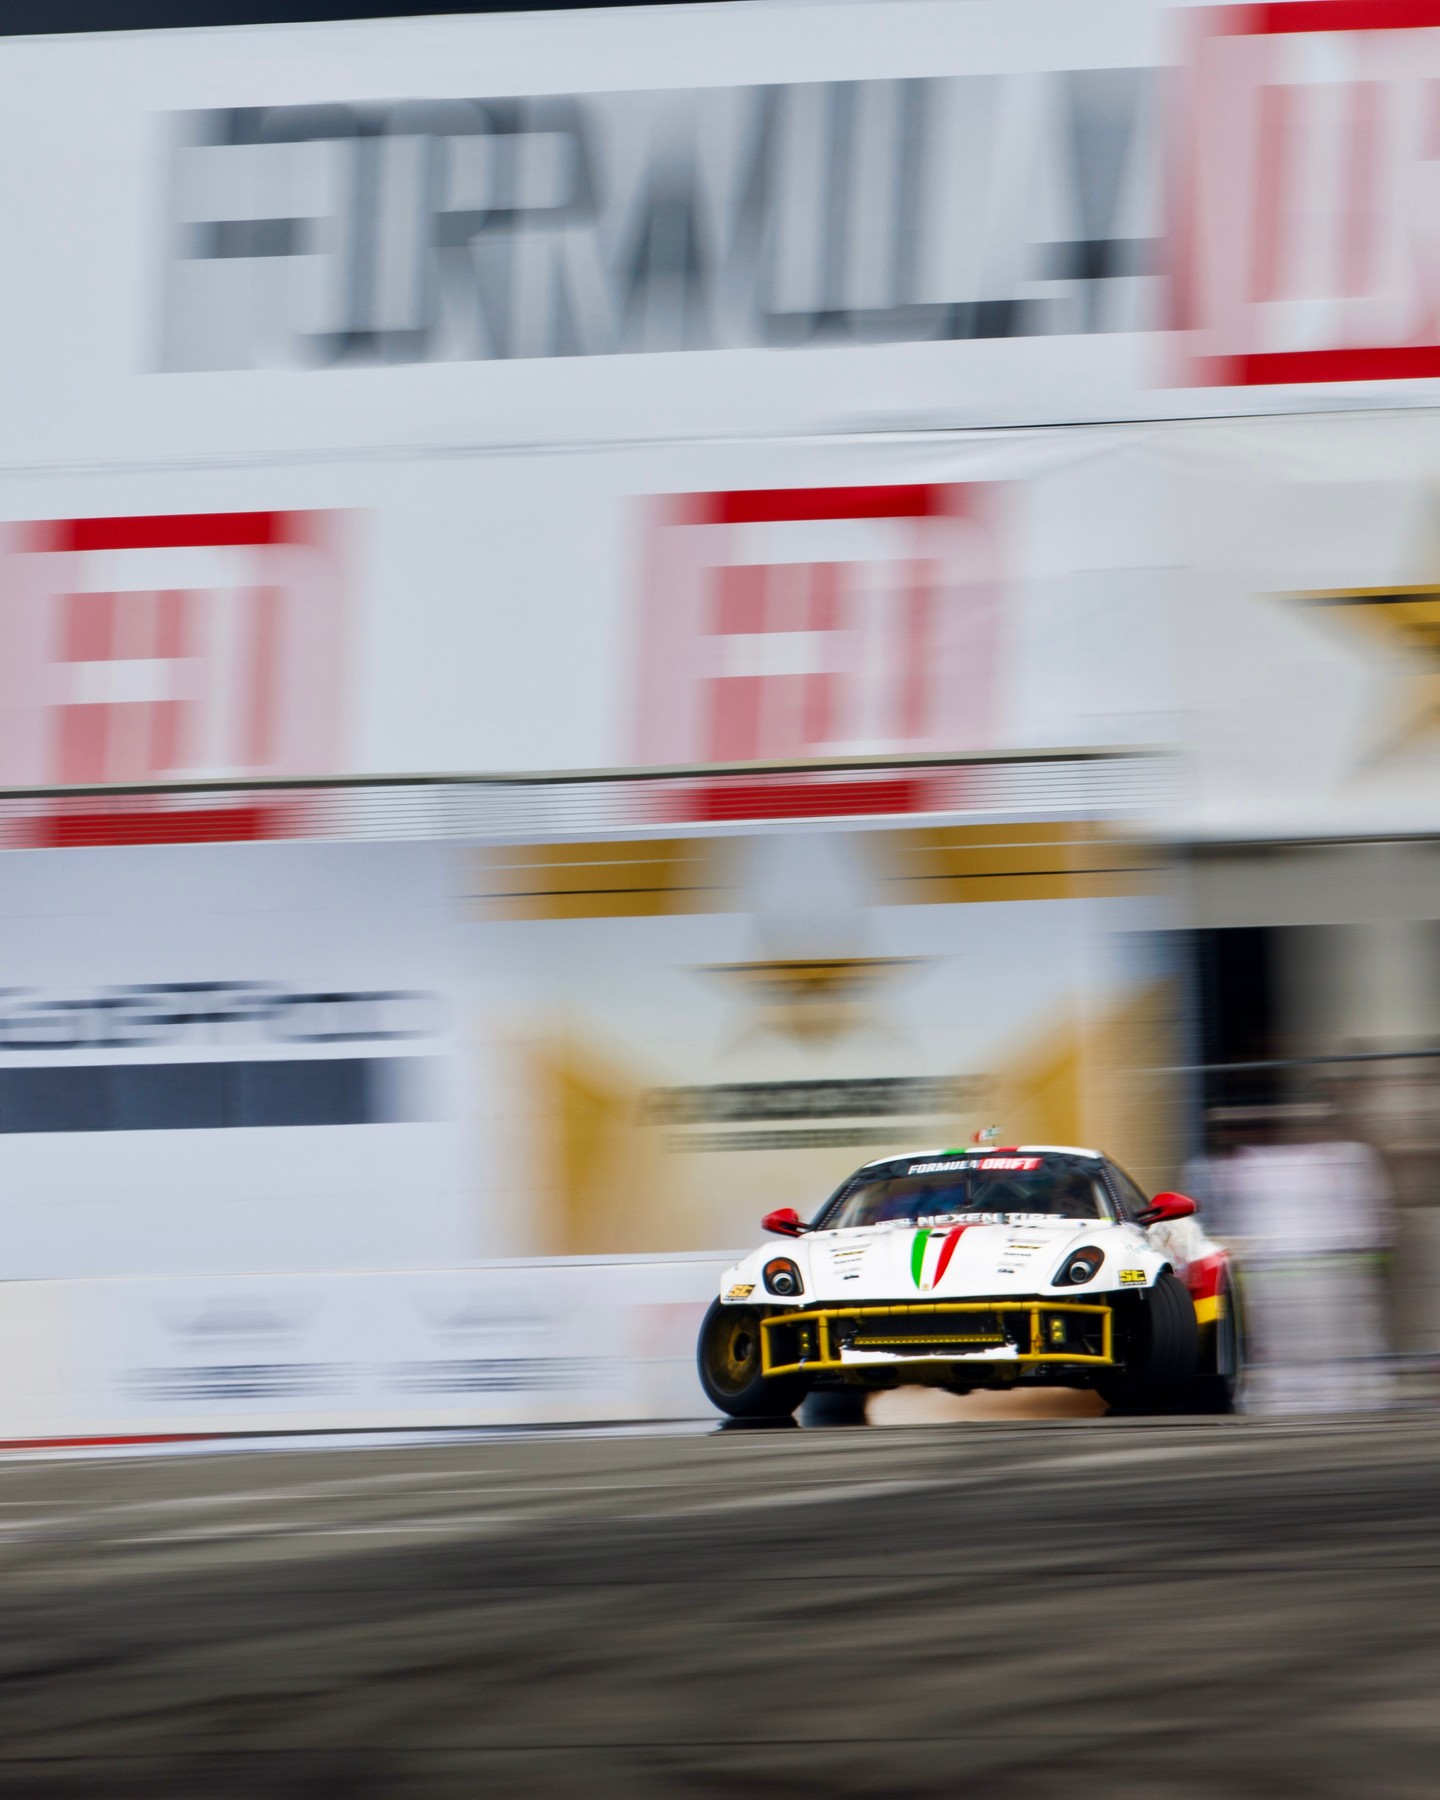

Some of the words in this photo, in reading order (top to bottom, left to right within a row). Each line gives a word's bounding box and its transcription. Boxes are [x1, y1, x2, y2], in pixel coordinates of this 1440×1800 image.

[907, 1160, 977, 1175] FORMULA
[980, 1157, 1036, 1170] DRIFT
[917, 1213, 998, 1226] NEXEN
